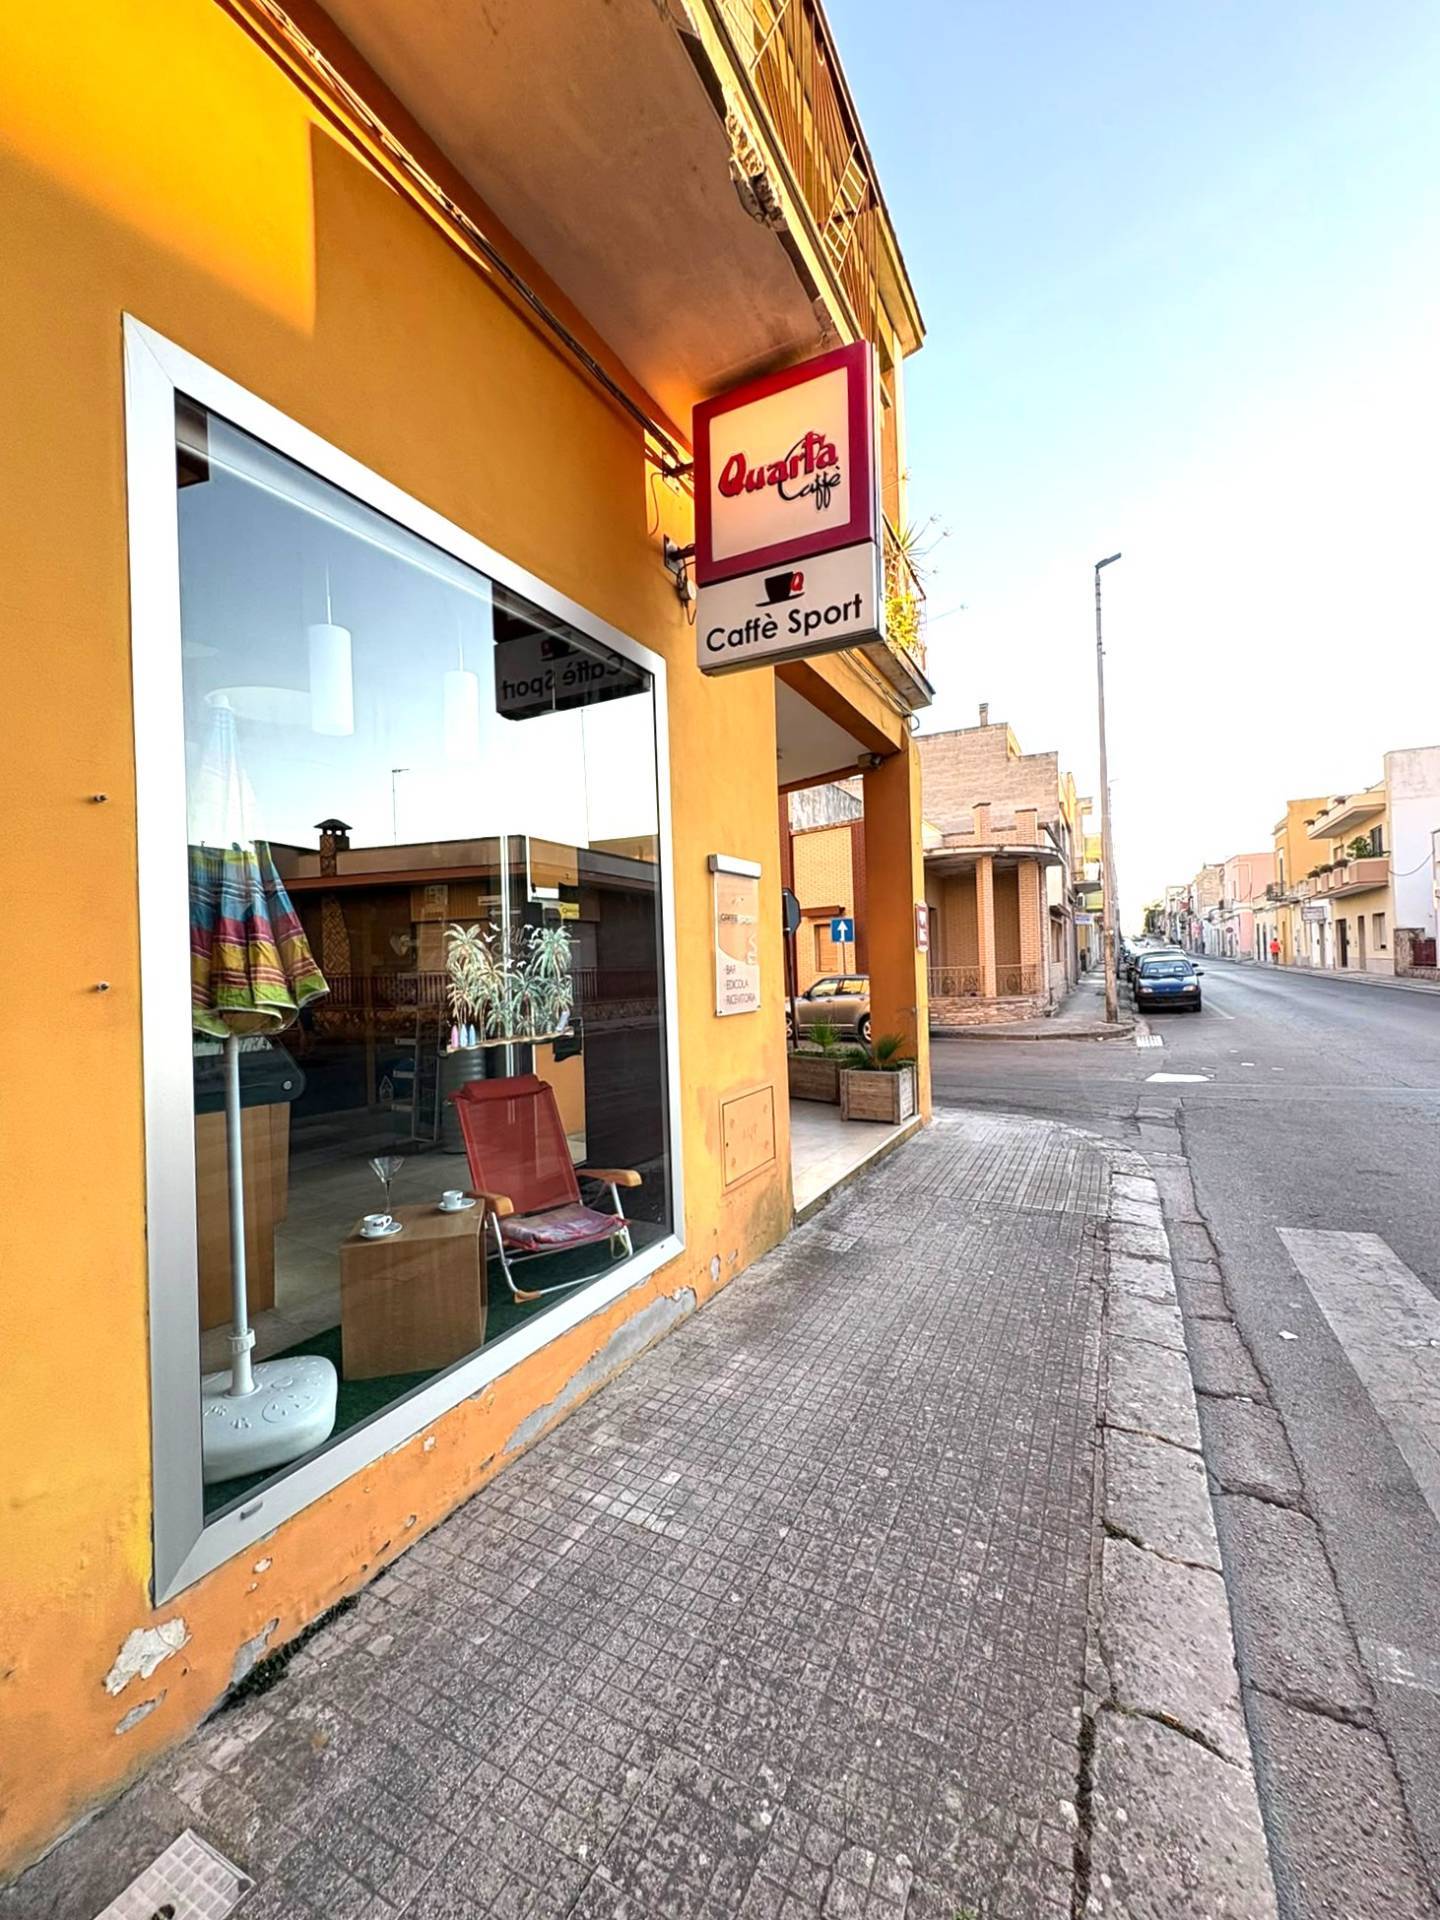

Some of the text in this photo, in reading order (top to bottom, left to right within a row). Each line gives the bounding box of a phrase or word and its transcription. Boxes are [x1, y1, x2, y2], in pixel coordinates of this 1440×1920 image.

[718, 431, 838, 497] Quarta
[706, 593, 863, 651] Caffè Sport
